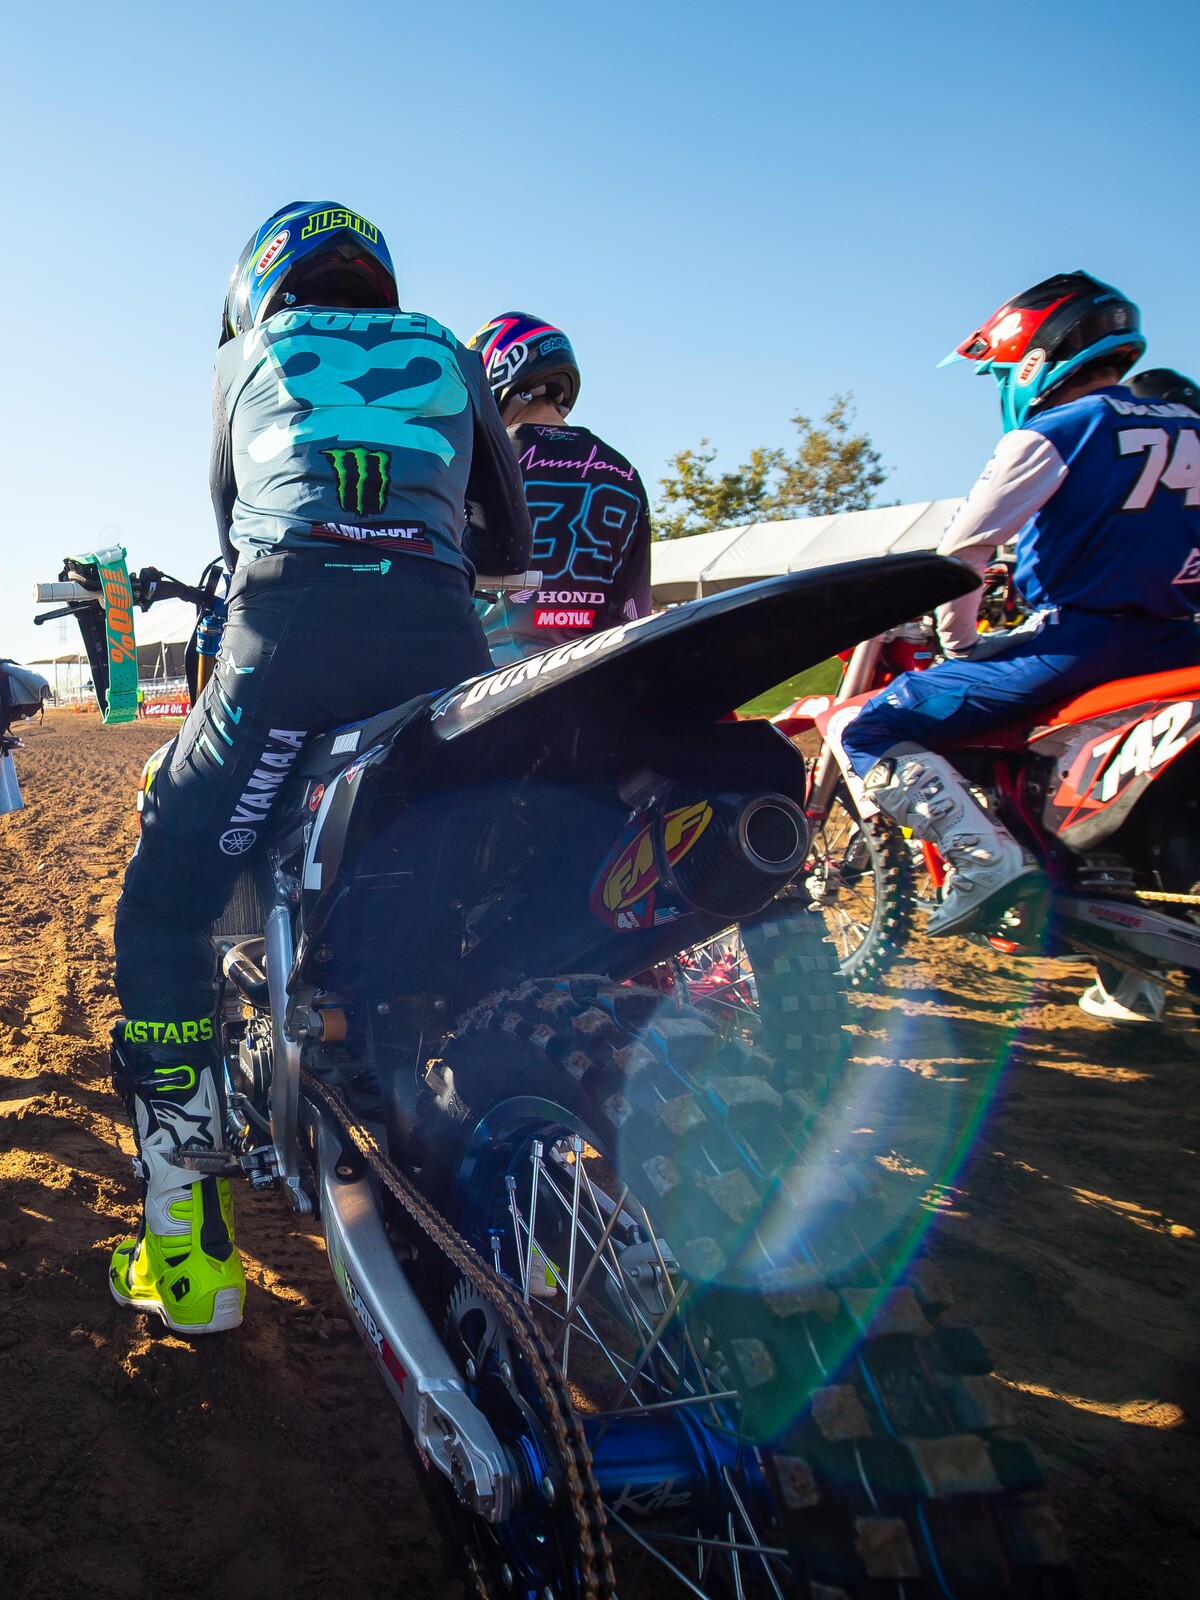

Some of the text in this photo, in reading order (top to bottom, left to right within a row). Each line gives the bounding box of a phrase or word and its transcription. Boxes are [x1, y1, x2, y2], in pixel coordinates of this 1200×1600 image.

[302, 209, 377, 243] JUSTIN
[259, 237, 286, 269] BELL
[242, 311, 458, 361] COOPER
[1020, 356, 1041, 381] BELL
[247, 334, 468, 467] 32
[1117, 428, 1200, 510] 74
[522, 481, 641, 584] 39
[101, 566, 136, 663] 100%
[537, 612, 591, 625] MOTUL
[460, 611, 666, 710] DUNLOP
[145, 704, 170, 714] LUCAS
[170, 704, 183, 714] OIL
[1092, 701, 1194, 802] 742
[608, 800, 708, 912] FMF
[124, 1018, 214, 1044] ASTARS
[612, 1478, 691, 1515] Kite
